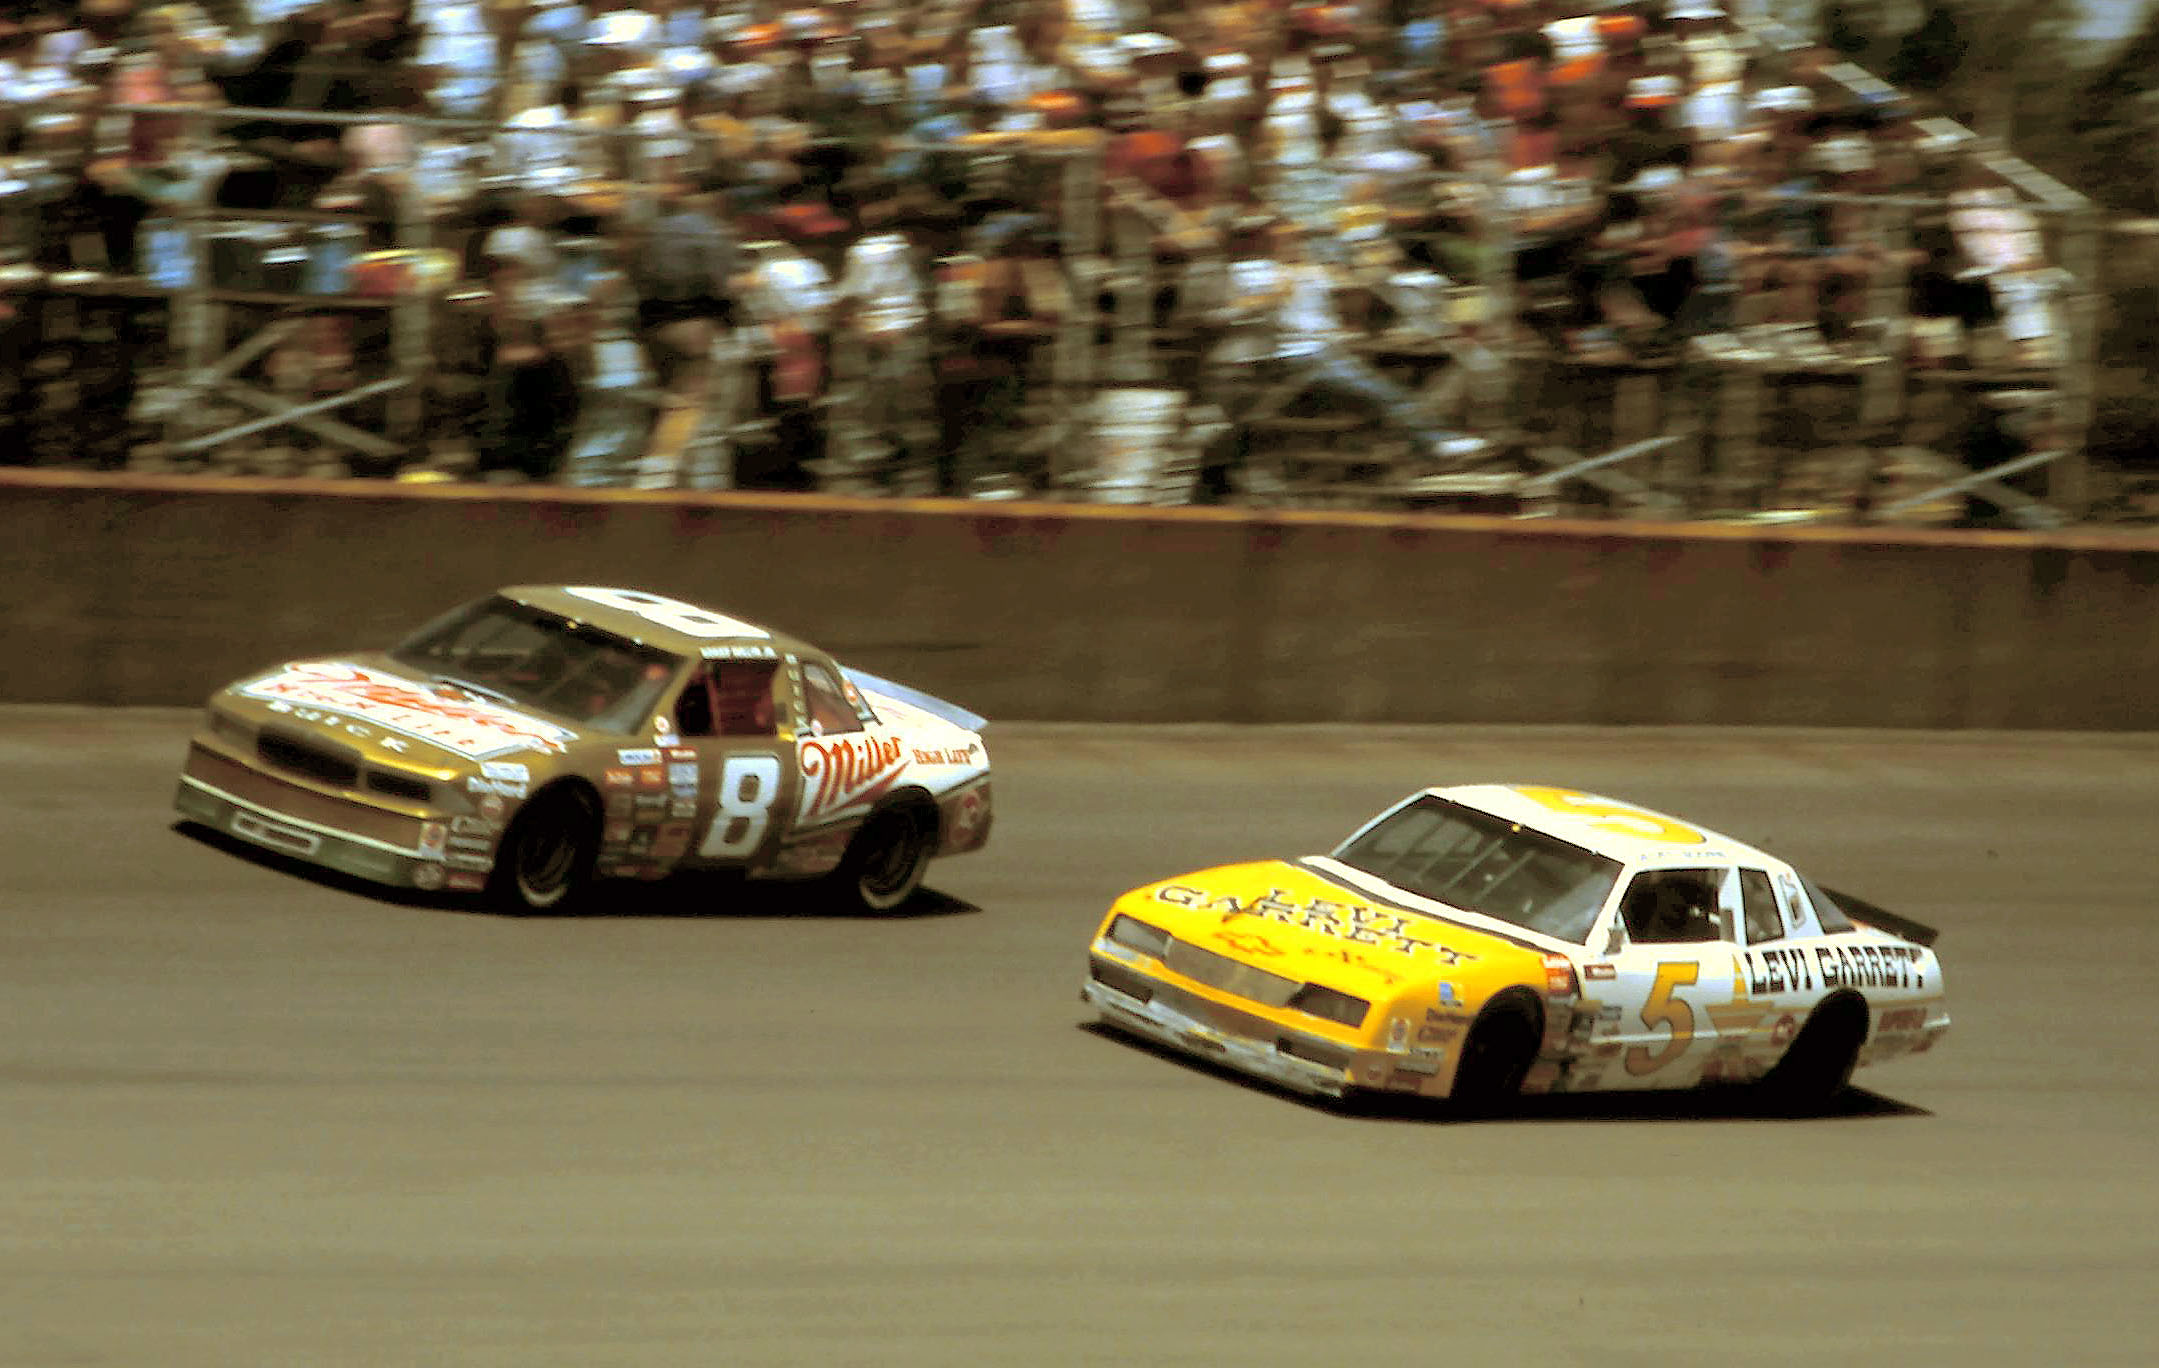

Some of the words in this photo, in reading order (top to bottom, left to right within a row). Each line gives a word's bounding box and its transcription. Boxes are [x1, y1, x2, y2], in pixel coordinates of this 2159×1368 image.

[563, 587, 771, 639] 8
[700, 756, 781, 857] 8
[801, 736, 901, 816] Miller
[1513, 786, 1707, 844] 5
[1745, 948, 1812, 994] LEVI
[1815, 946, 1923, 989] GARRETT
[1625, 961, 1700, 1077] 5
